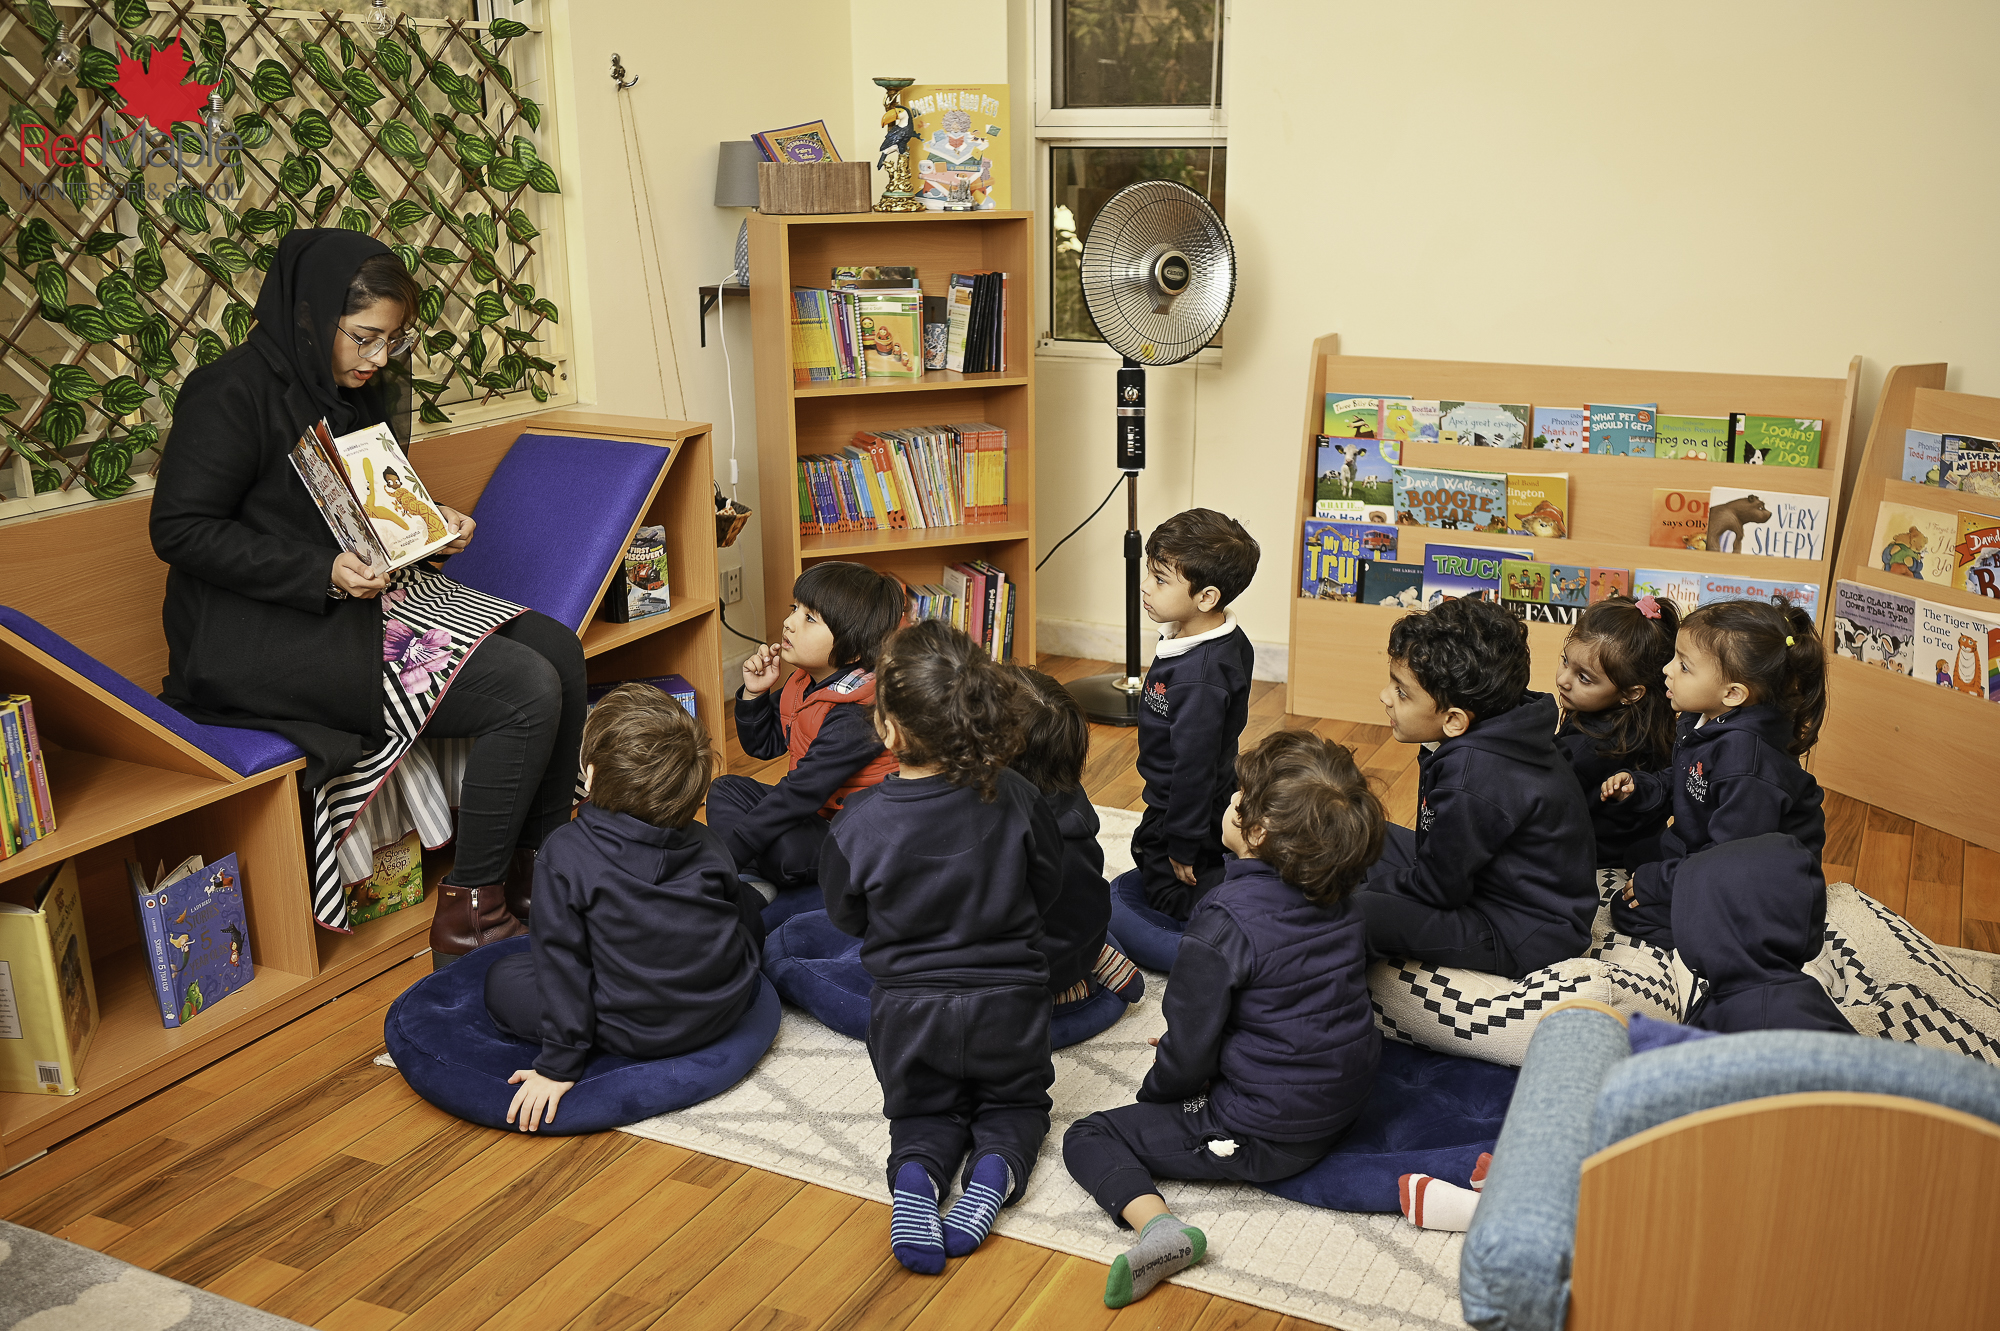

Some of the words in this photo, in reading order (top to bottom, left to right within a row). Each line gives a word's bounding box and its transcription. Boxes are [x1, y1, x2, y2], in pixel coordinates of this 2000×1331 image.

[908, 95, 935, 118] BOOKS
[936, 92, 957, 112] MAKE
[960, 91, 979, 112] GOOD
[981, 93, 999, 118] PETS
[1448, 416, 1468, 428] Ape's
[1471, 419, 1490, 430] great
[1493, 421, 1518, 431] escape
[1551, 418, 1579, 426] Phonics
[1591, 413, 1615, 422] WHAT
[1619, 413, 1636, 421] PET
[1592, 421, 1623, 432] SHOULD
[1625, 422, 1629, 430] I
[1631, 422, 1653, 432] GET?
[1541, 424, 1566, 436] Shark
[1569, 427, 1579, 437] in
[1663, 424, 1692, 432] Phonics
[1694, 426, 1725, 434] Readers
[1656, 432, 1678, 448] Frog
[1683, 438, 1697, 447] on
[1701, 439, 1708, 447] a
[1714, 436, 1728, 451] log
[1761, 436, 1796, 450] After
[1797, 444, 1807, 453] a
[1908, 447, 1924, 460] Toad
[1399, 475, 1439, 490] David
[1442, 477, 1499, 496] Walliams
[1405, 488, 1493, 513] BOOGIE
[1423, 506, 1474, 524] BEAR
[1777, 504, 1821, 531] VERY
[1662, 519, 1683, 529] says
[1685, 519, 1708, 531] Olly
[1324, 536, 1339, 554] My
[1342, 537, 1360, 556] Big
[1752, 526, 1820, 560] SLEEPY
[1970, 529, 2000, 551] David
[1682, 577, 1695, 585] How
[1706, 582, 1741, 594] Come
[1525, 603, 1586, 625] FAM
[1845, 601, 1865, 612] Cows
[1866, 605, 1885, 617] That
[1888, 611, 1908, 623] Type
[1897, 604, 1914, 615] MOO
[1923, 607, 1941, 621] The
[1944, 613, 1970, 629] Tiger
[1923, 621, 1951, 637] Came
[1923, 635, 1932, 645] to
[1935, 637, 1953, 651] Tea
[37, 763, 45, 787] MATILDA
[385, 846, 411, 862] Stories
[376, 859, 407, 881] Aesop
[190, 898, 212, 913] LADYBIRD
[184, 902, 219, 932] STORIES
[200, 930, 212, 950] 5
[189, 953, 210, 977] YEAR
[210, 942, 229, 961] OLDS
